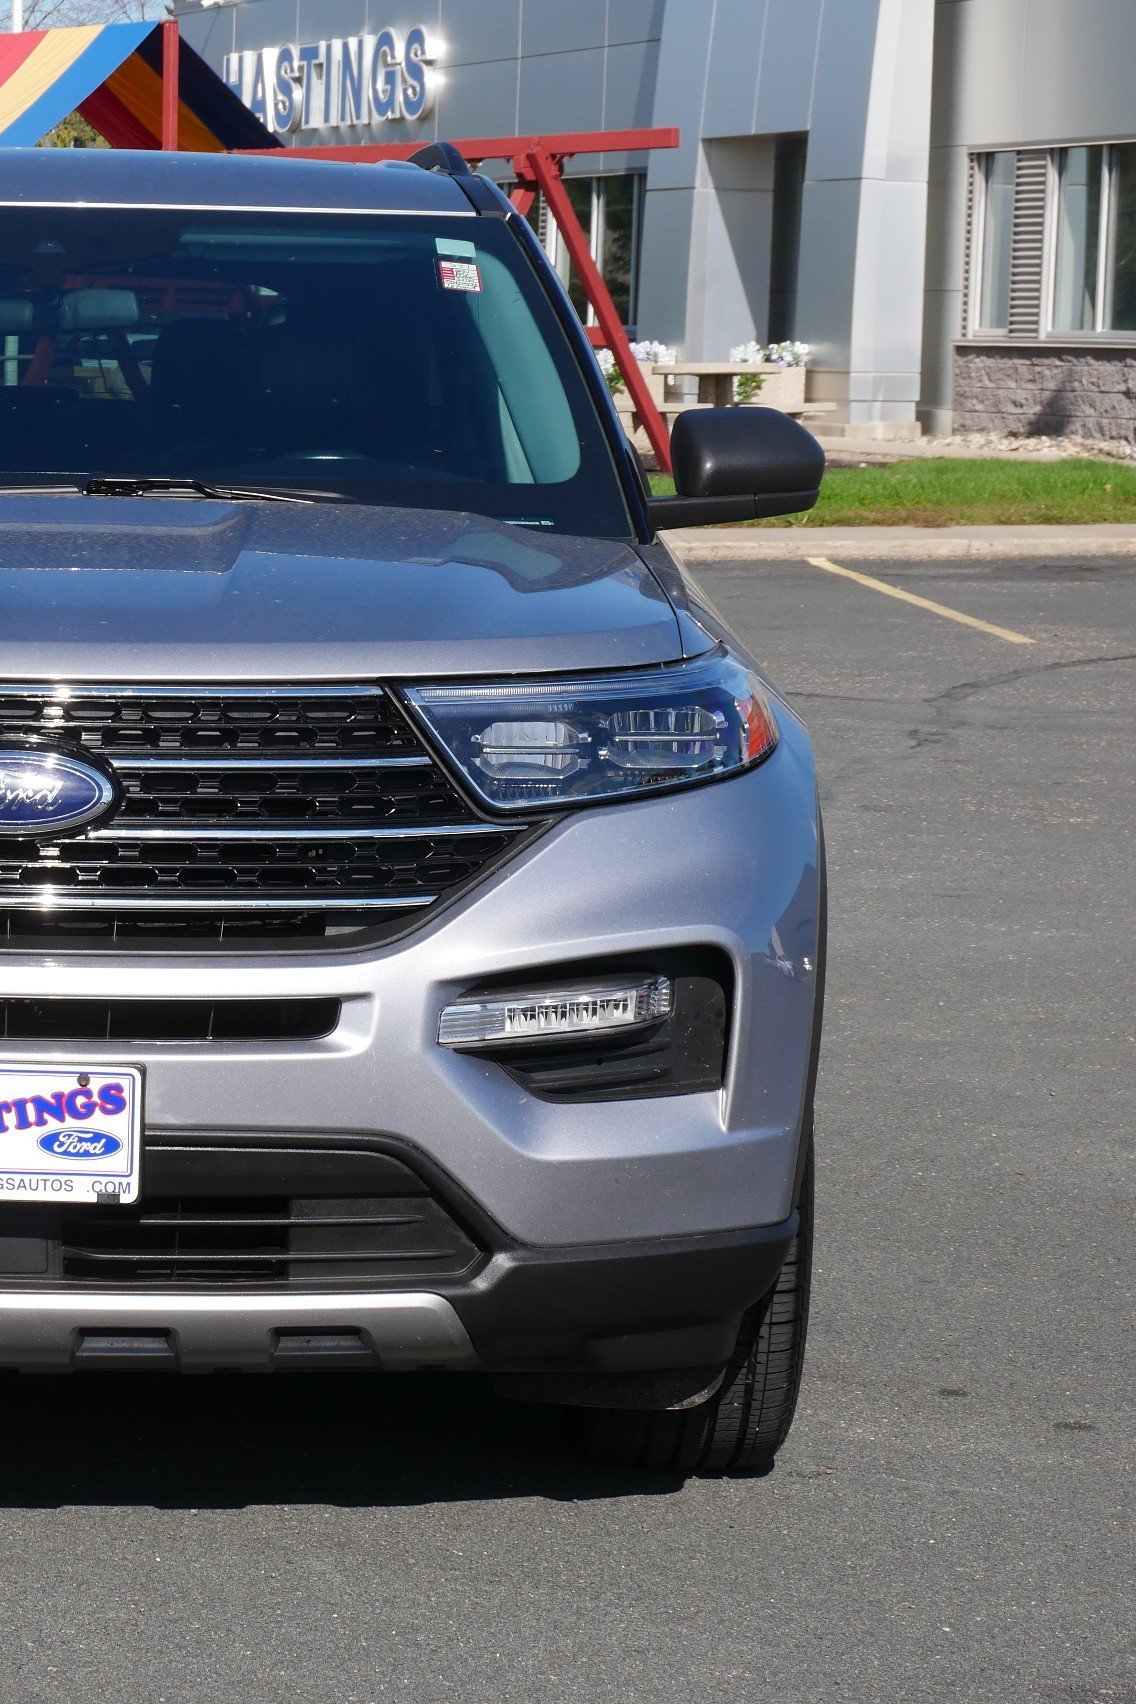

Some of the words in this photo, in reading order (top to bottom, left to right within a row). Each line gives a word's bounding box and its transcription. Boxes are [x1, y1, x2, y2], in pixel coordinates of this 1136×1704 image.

[223, 24, 438, 133] HASTINGS
[52, 1130, 106, 1155] Ford
[86, 1179, 132, 1195] .COM
